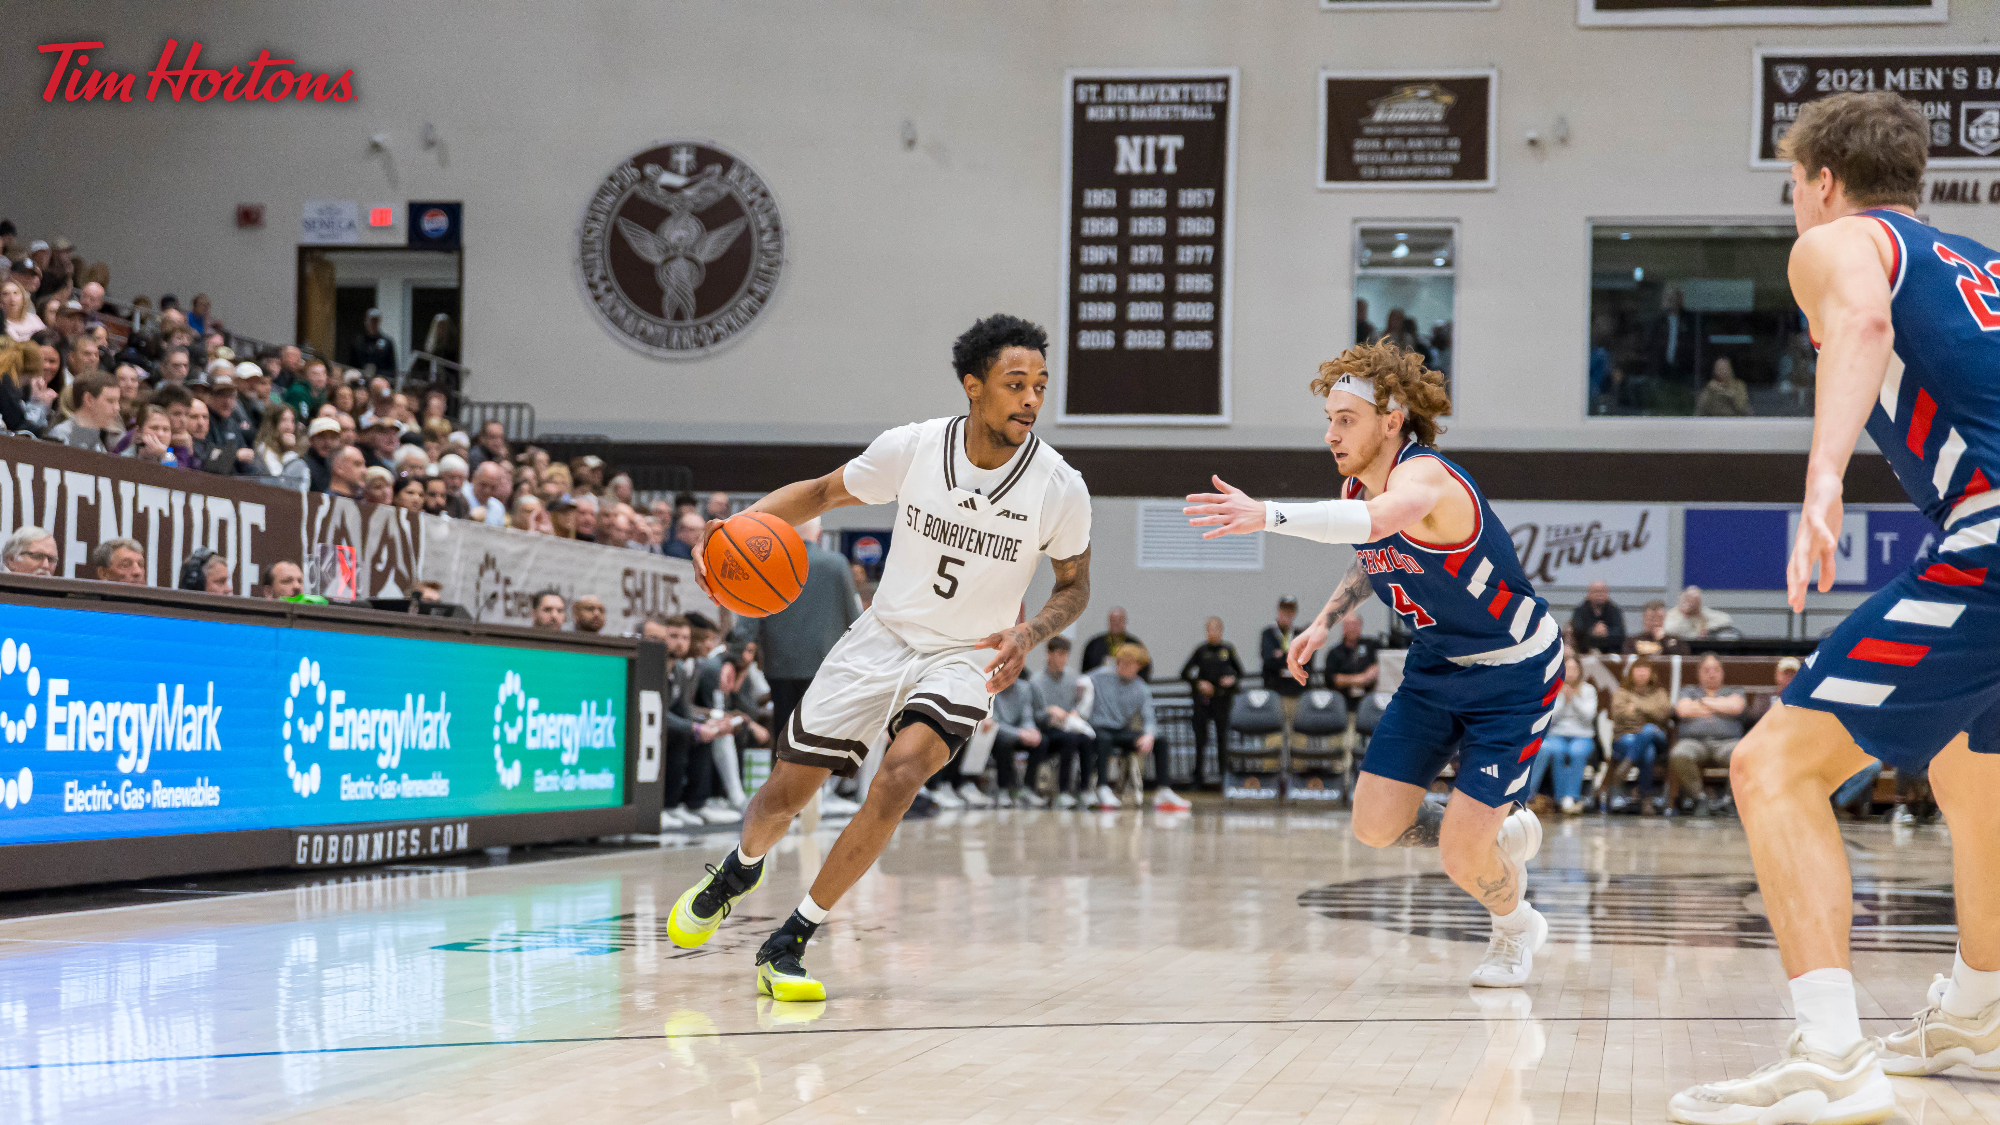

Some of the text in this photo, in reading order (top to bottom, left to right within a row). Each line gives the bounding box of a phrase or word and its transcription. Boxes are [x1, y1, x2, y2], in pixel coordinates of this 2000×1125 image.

[1076, 82, 1227, 104] ST. BONAVENTURE
[1816, 68, 1875, 91] 2021
[1884, 67, 1968, 91] MEN'S
[1128, 104, 1215, 121] BASKETBALL
[1114, 135, 1185, 174] NIT
[1129, 188, 1167, 209] 1952
[1178, 188, 1215, 209] 1957
[1930, 180, 1981, 203] HALL
[1129, 245, 1163, 265] 1971
[1176, 245, 1214, 265] 1977
[1126, 301, 1164, 322] 2001
[907, 504, 1022, 562] ST. BONAVENTURE
[1509, 510, 1650, 582] Unfurl
[724, 549, 750, 581] adidas
[932, 554, 965, 600] 5
[1388, 583, 1437, 629] 4
[46, 679, 222, 773] EnergyMark
[328, 690, 451, 769] EnergyMark
[526, 697, 616, 766] EnergyMark
[637, 690, 663, 783] B
[297, 823, 469, 865] GOBONNIES.COM
